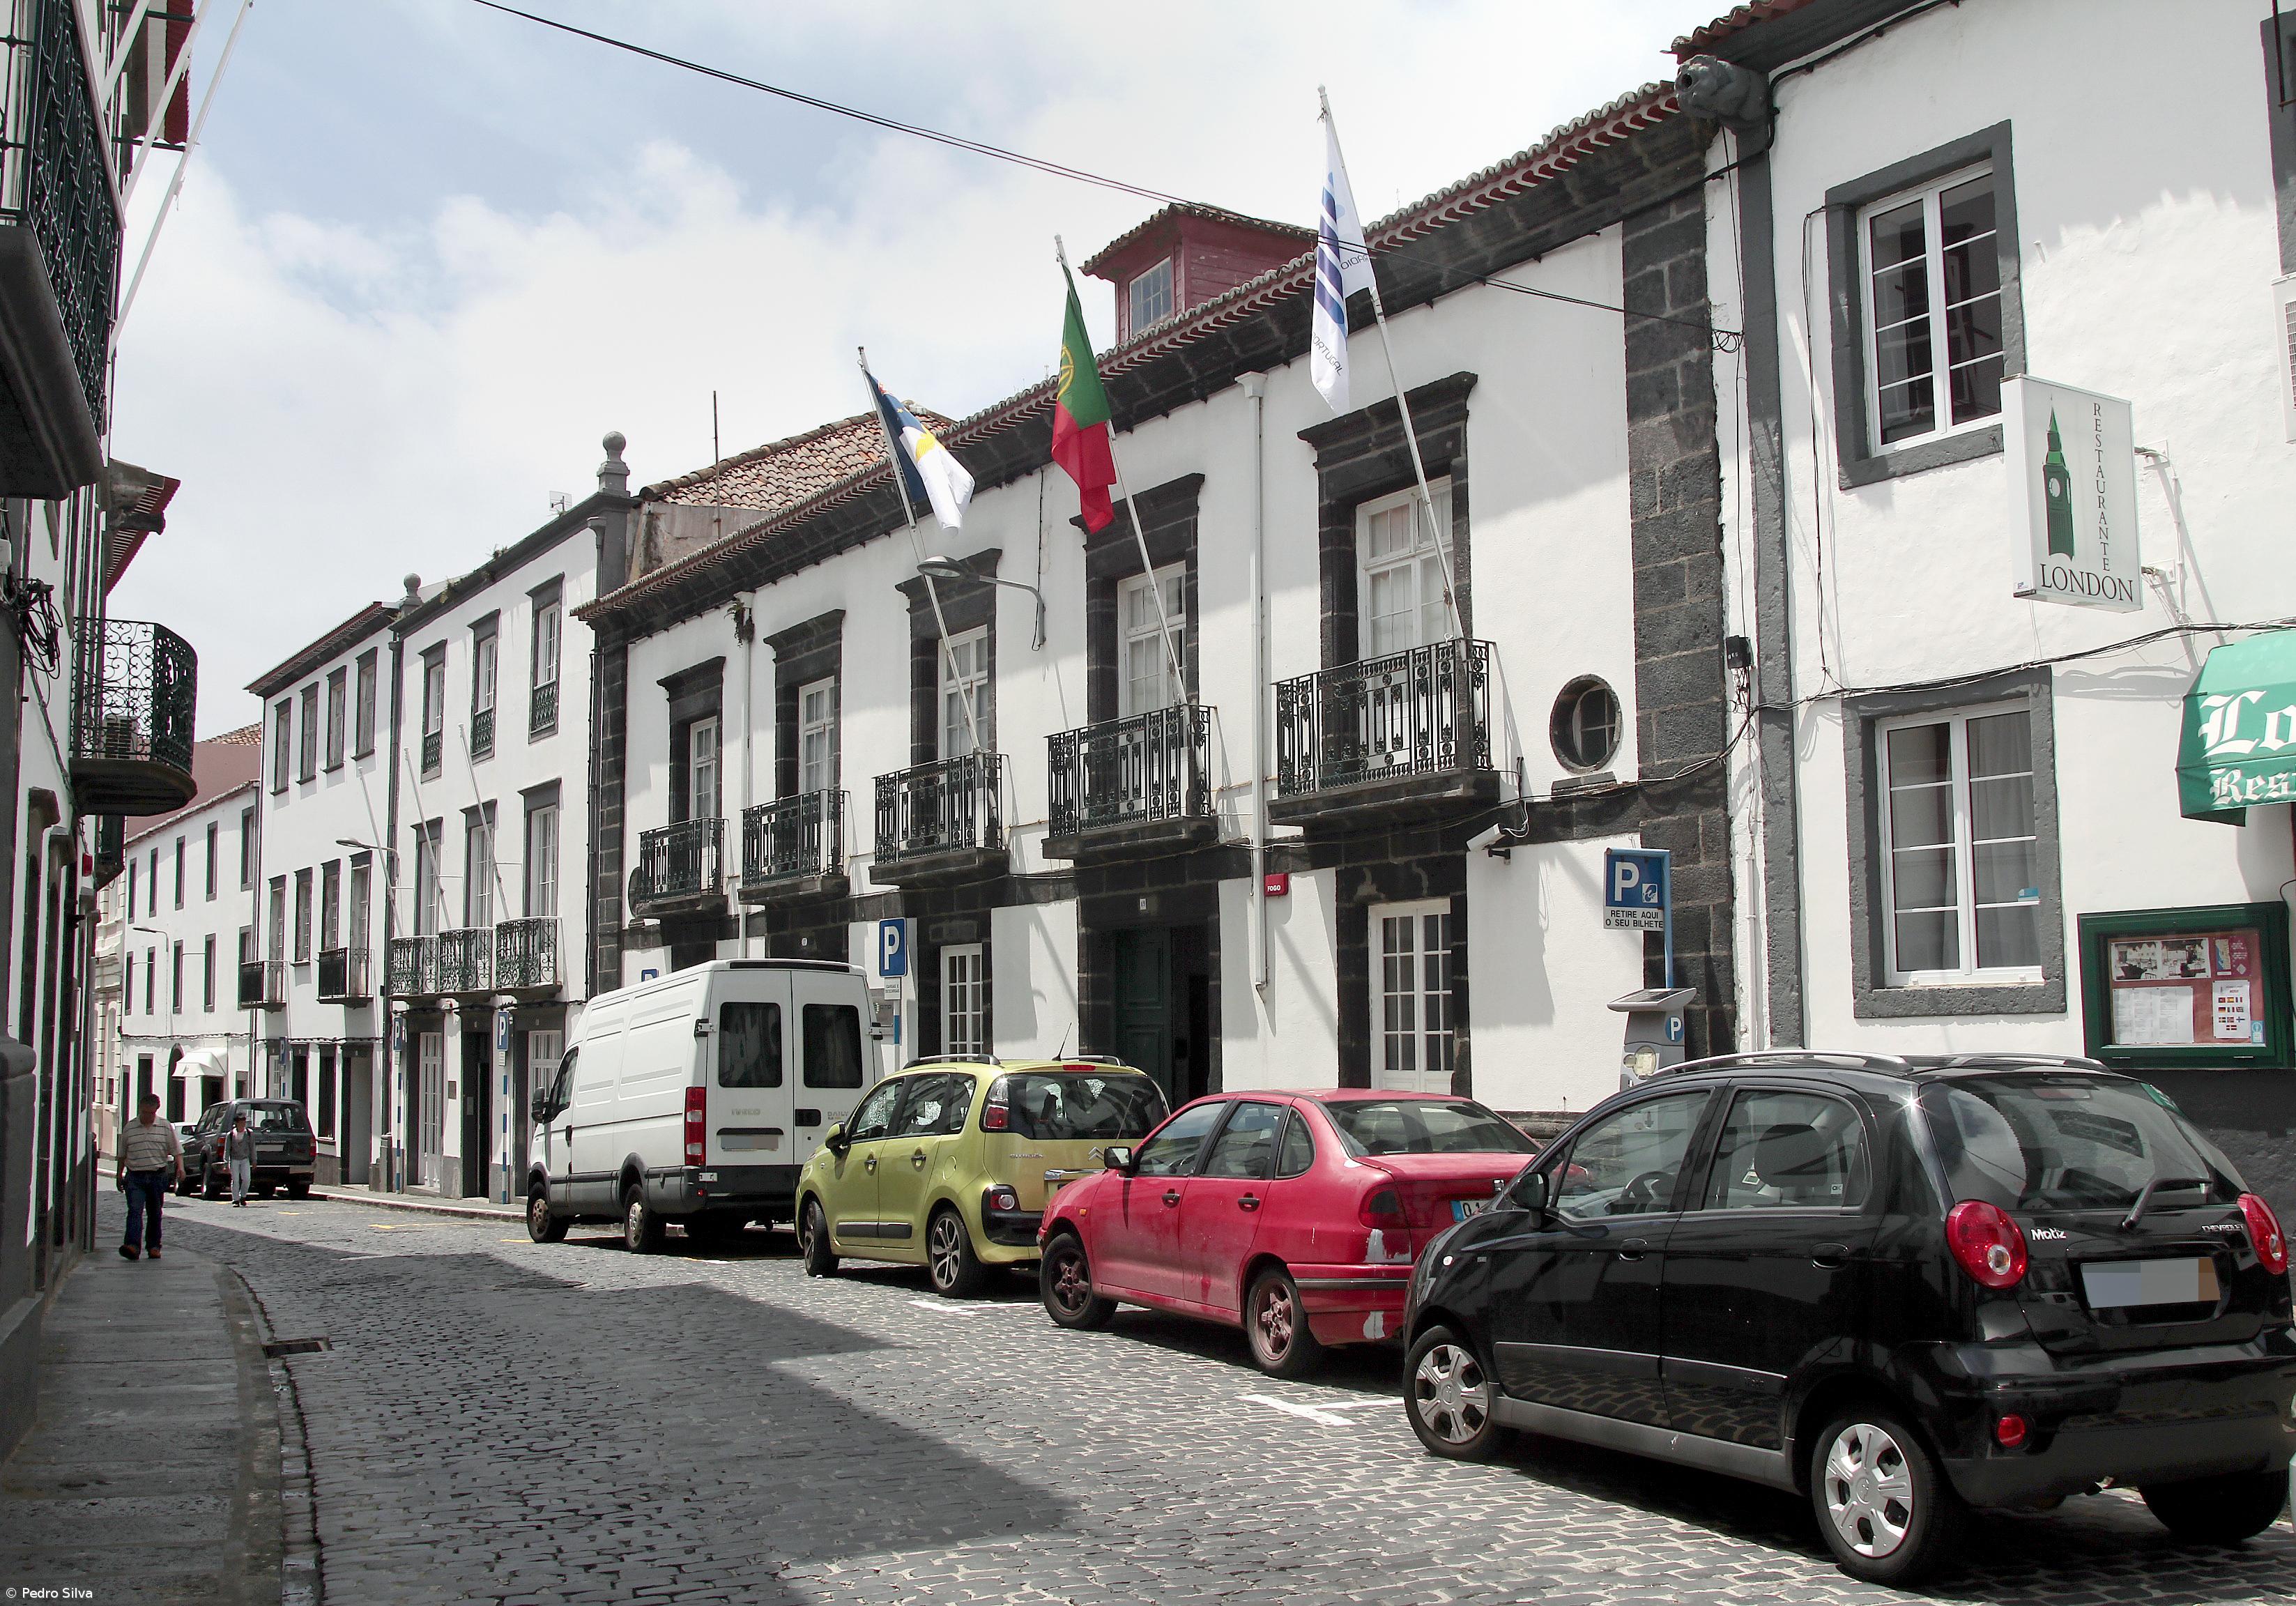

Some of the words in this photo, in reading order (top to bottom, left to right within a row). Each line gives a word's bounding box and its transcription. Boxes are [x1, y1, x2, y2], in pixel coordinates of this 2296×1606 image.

[2093, 402, 2111, 572] RESTAURANTE
[2039, 563, 2134, 603] LONDON
[2209, 767, 2296, 806] Res
[1614, 861, 1639, 901] P
[1610, 910, 1637, 919] RETIRE
[1641, 911, 1658, 919] AQUI
[1615, 919, 1630, 927] SEU
[1633, 919, 1664, 928] BILHETE
[884, 926, 900, 970] P
[499, 1016, 506, 1046] P
[1670, 1017, 1682, 1041] P
[2030, 1227, 2067, 1241] Matiz
[2201, 1223, 2244, 1233] CHEVROLET
